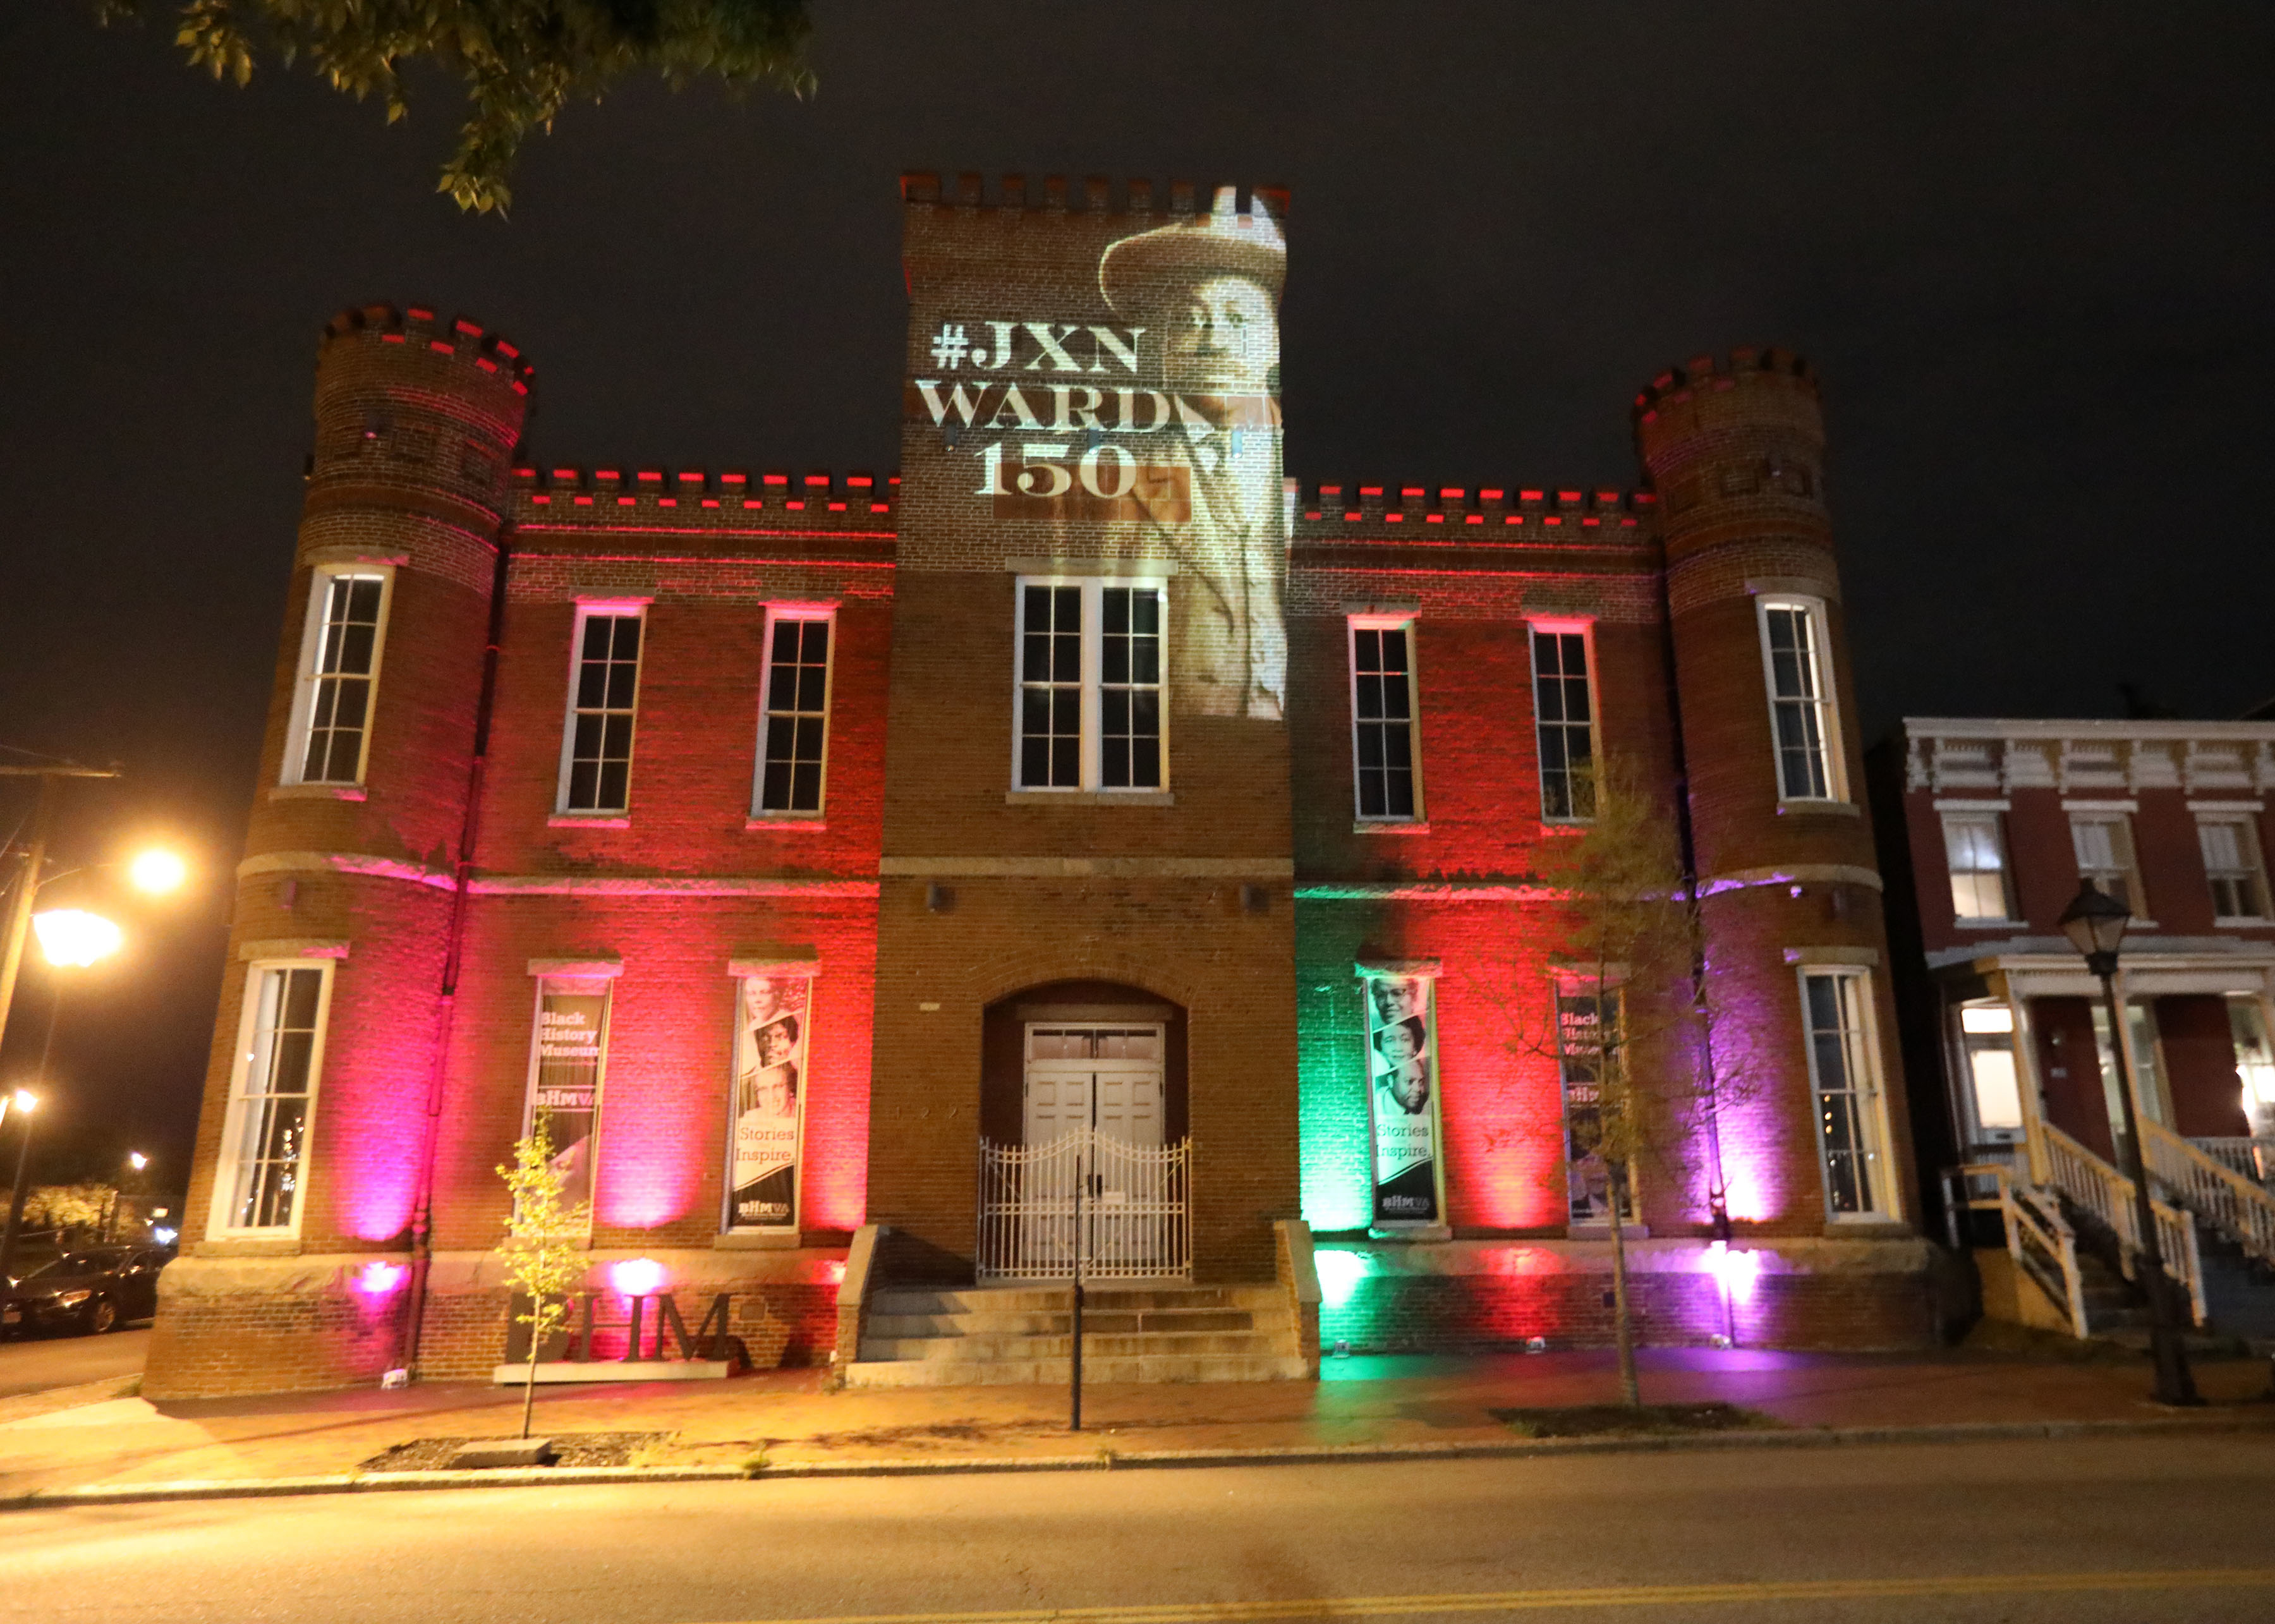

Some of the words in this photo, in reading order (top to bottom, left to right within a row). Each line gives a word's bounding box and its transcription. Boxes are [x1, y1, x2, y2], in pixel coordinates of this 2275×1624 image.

[930, 321, 1146, 373] #JXN
[914, 380, 1171, 433] WARD
[973, 442, 1138, 499] 150
[541, 1011, 587, 1025] Black
[541, 1027, 598, 1045] History
[741, 1127, 794, 1141] Stories
[1377, 1124, 1429, 1137] Stories
